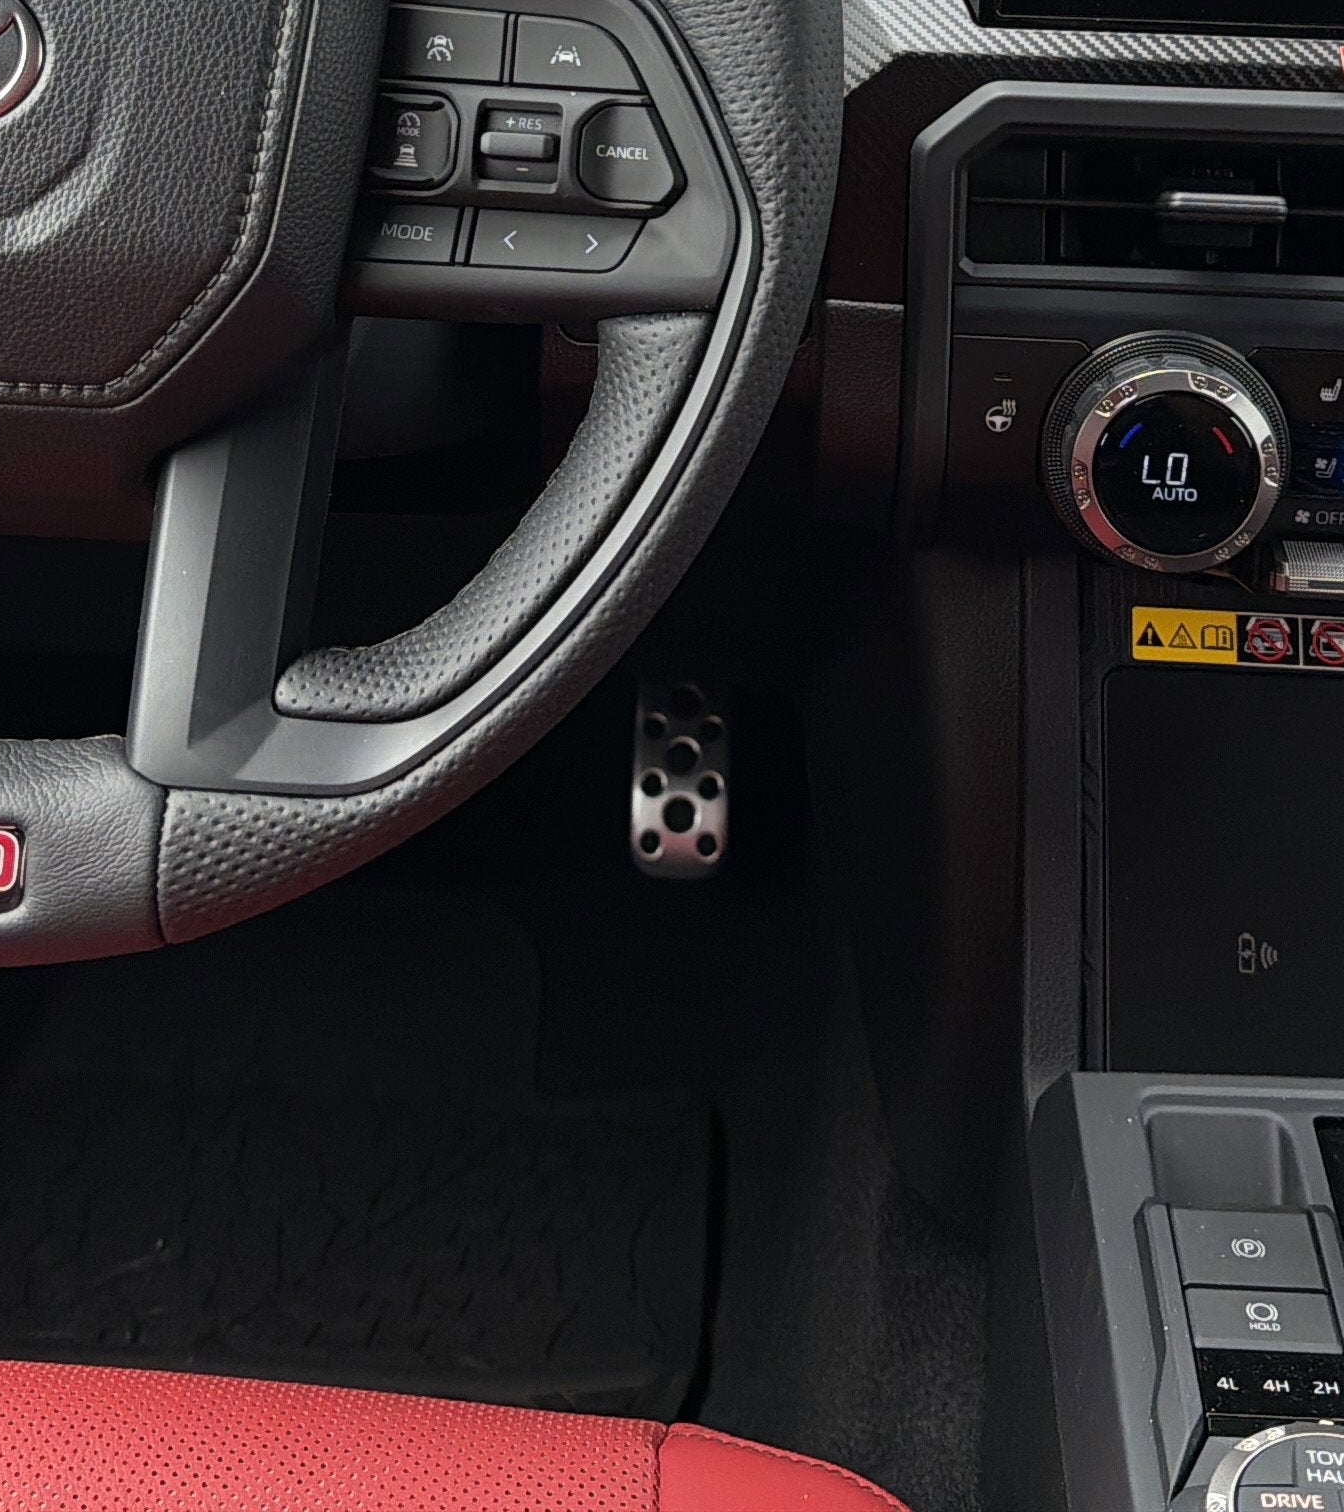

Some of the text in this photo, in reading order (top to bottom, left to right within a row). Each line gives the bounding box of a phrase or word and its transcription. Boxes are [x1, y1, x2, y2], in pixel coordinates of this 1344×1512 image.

[518, 117, 543, 131] RES
[396, 126, 421, 138] MODE
[595, 144, 649, 162] CANCEL
[381, 222, 434, 242] MODE
[1152, 487, 1198, 502] AUTO
[1249, 1321, 1281, 1332] HOLD
[1216, 1377, 1240, 1391] 4L
[1262, 1379, 1290, 1393] 4H
[1312, 1381, 1340, 1395] 2H
[1259, 1493, 1326, 1511] DRIVE
